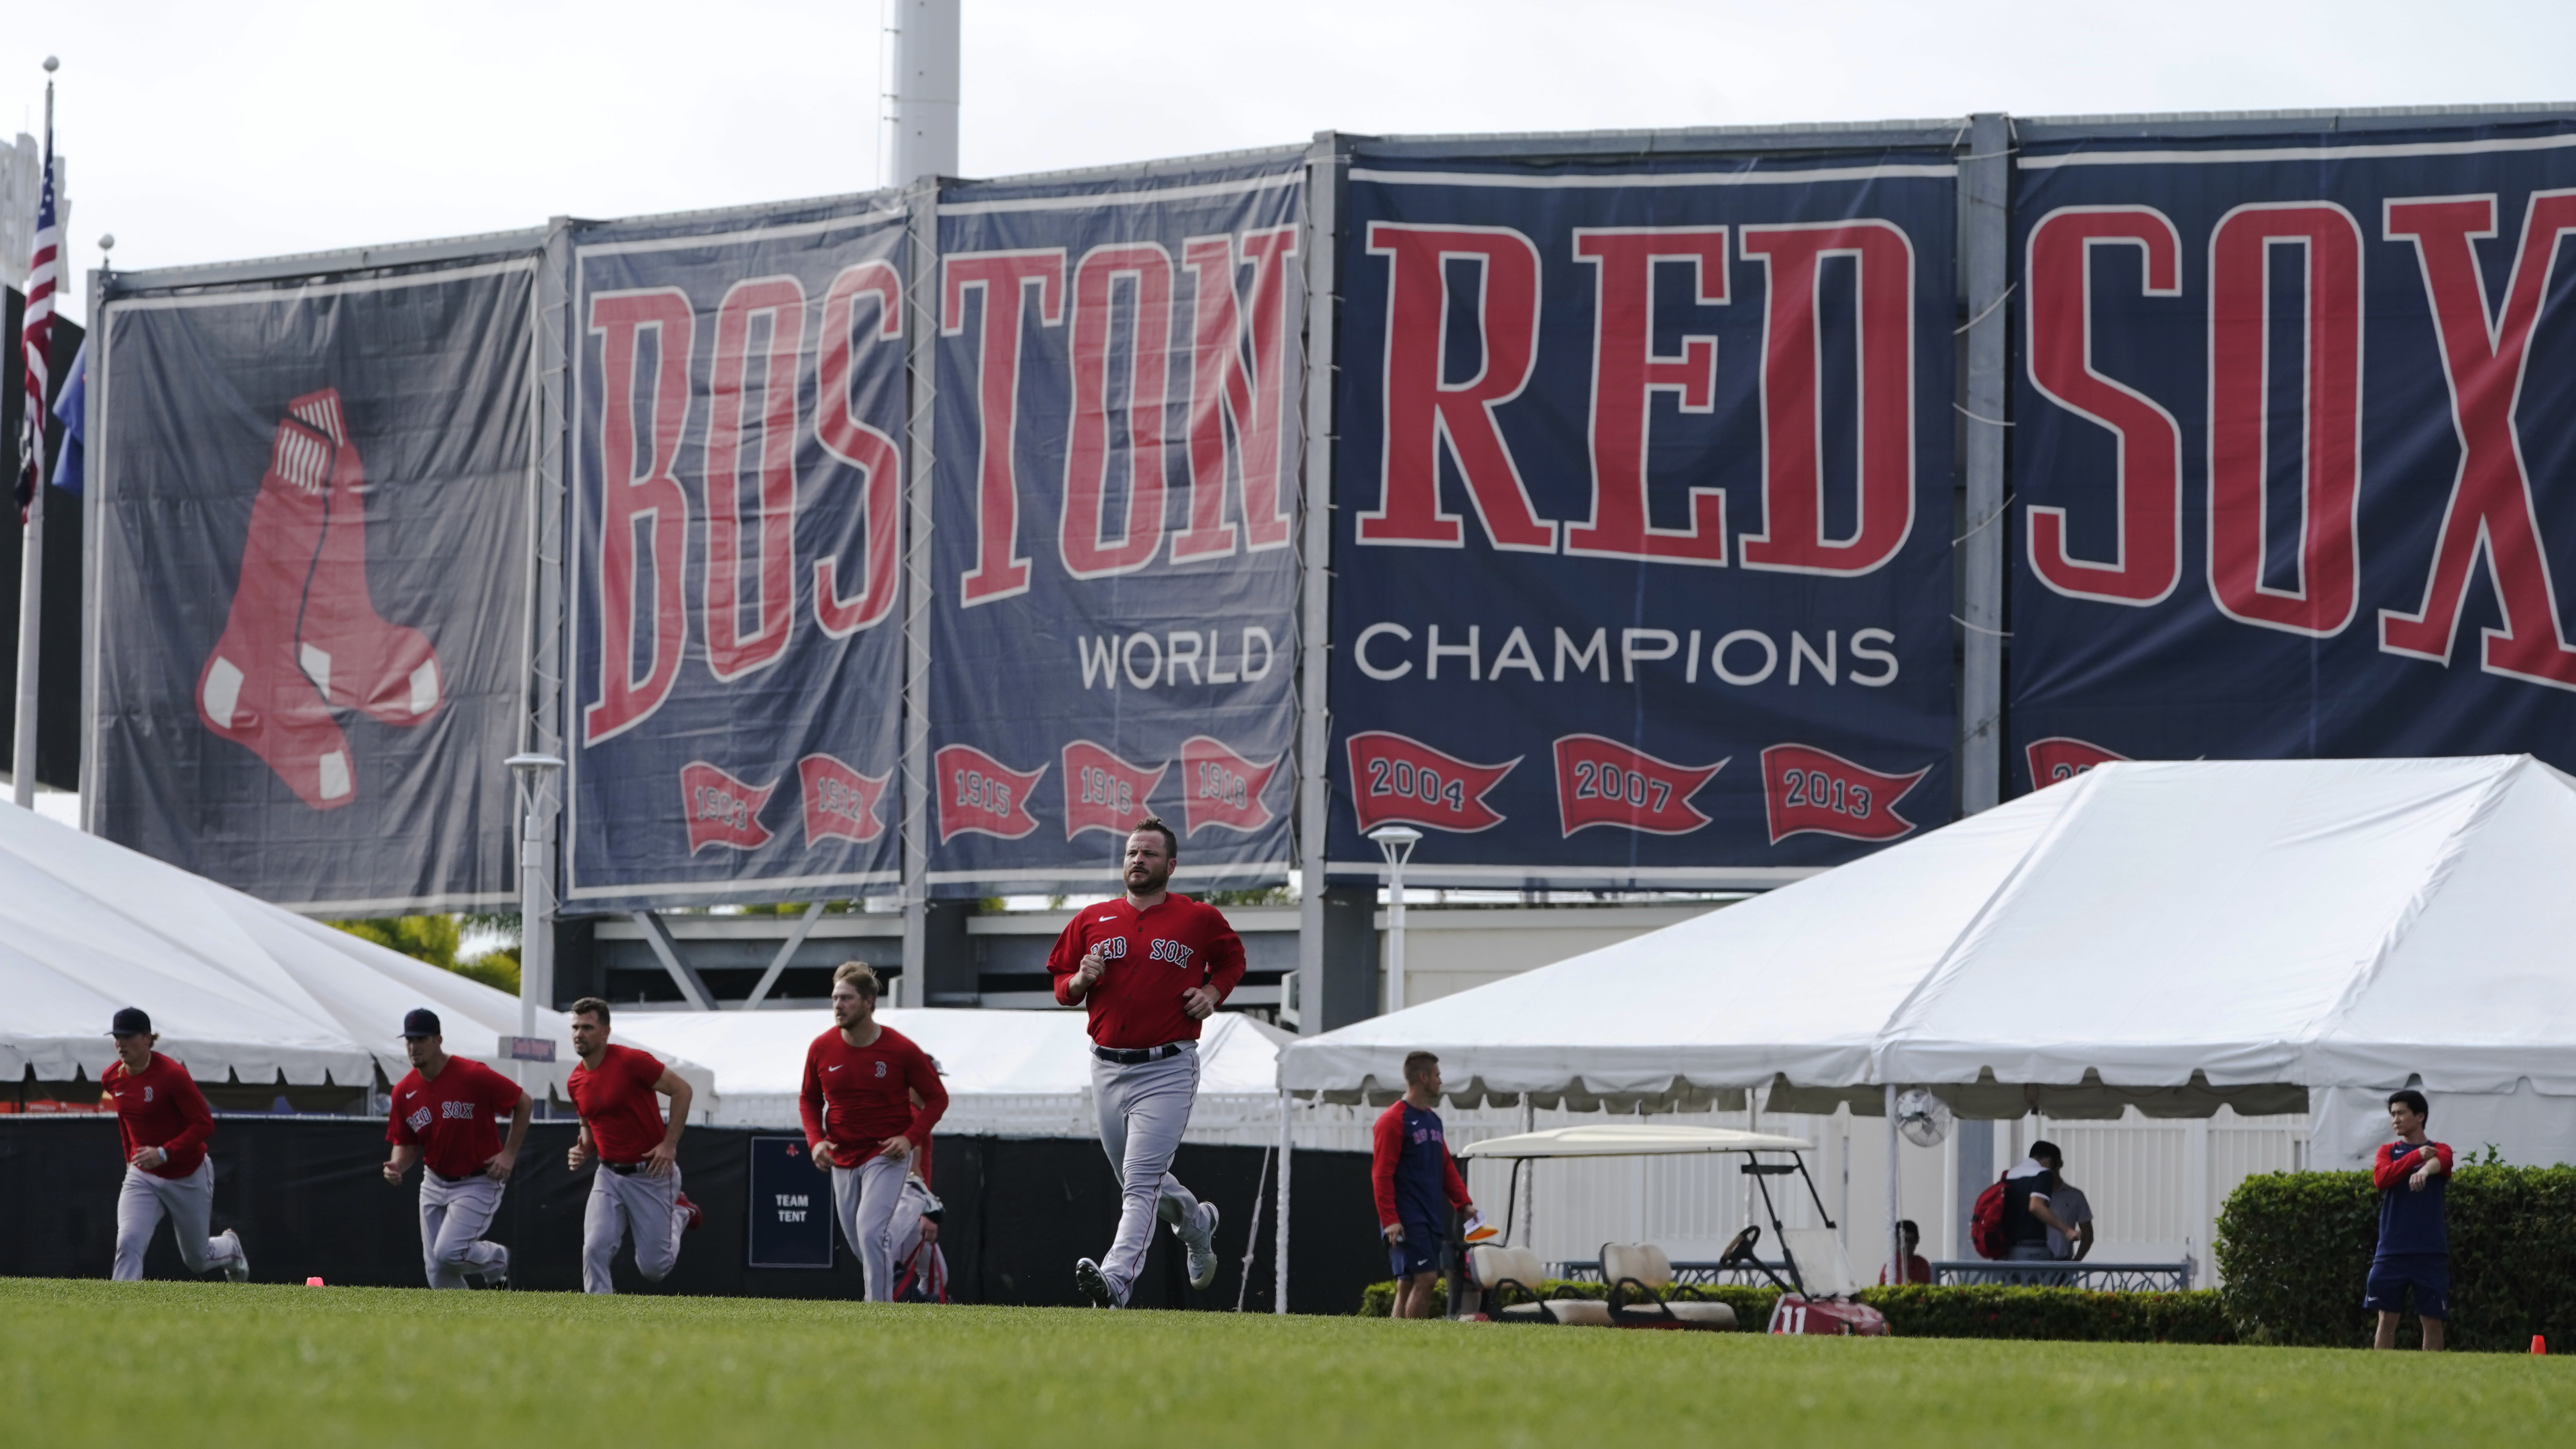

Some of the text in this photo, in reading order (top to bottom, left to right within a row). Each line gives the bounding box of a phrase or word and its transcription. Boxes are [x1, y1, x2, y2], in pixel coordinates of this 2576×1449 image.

[584, 188, 2576, 749] BOSTON RED SOX
[1078, 622, 1899, 690] WORLD CHAMPIONS
[696, 785, 747, 831] 1903
[818, 776, 862, 822] 1912
[956, 769, 1011, 818] 1915
[1081, 766, 1133, 815] 1916
[1198, 761, 1246, 810] 1918
[1368, 757, 1465, 812] 2004
[1575, 760, 1672, 813] 2007
[1783, 769, 1872, 819] 2013
[1150, 938, 1194, 969] SOX
[406, 1101, 475, 1133] RED SOX
[776, 1194, 809, 1207] TEAM
[777, 1209, 808, 1223] TENT
[1781, 1305, 1807, 1335] 11
